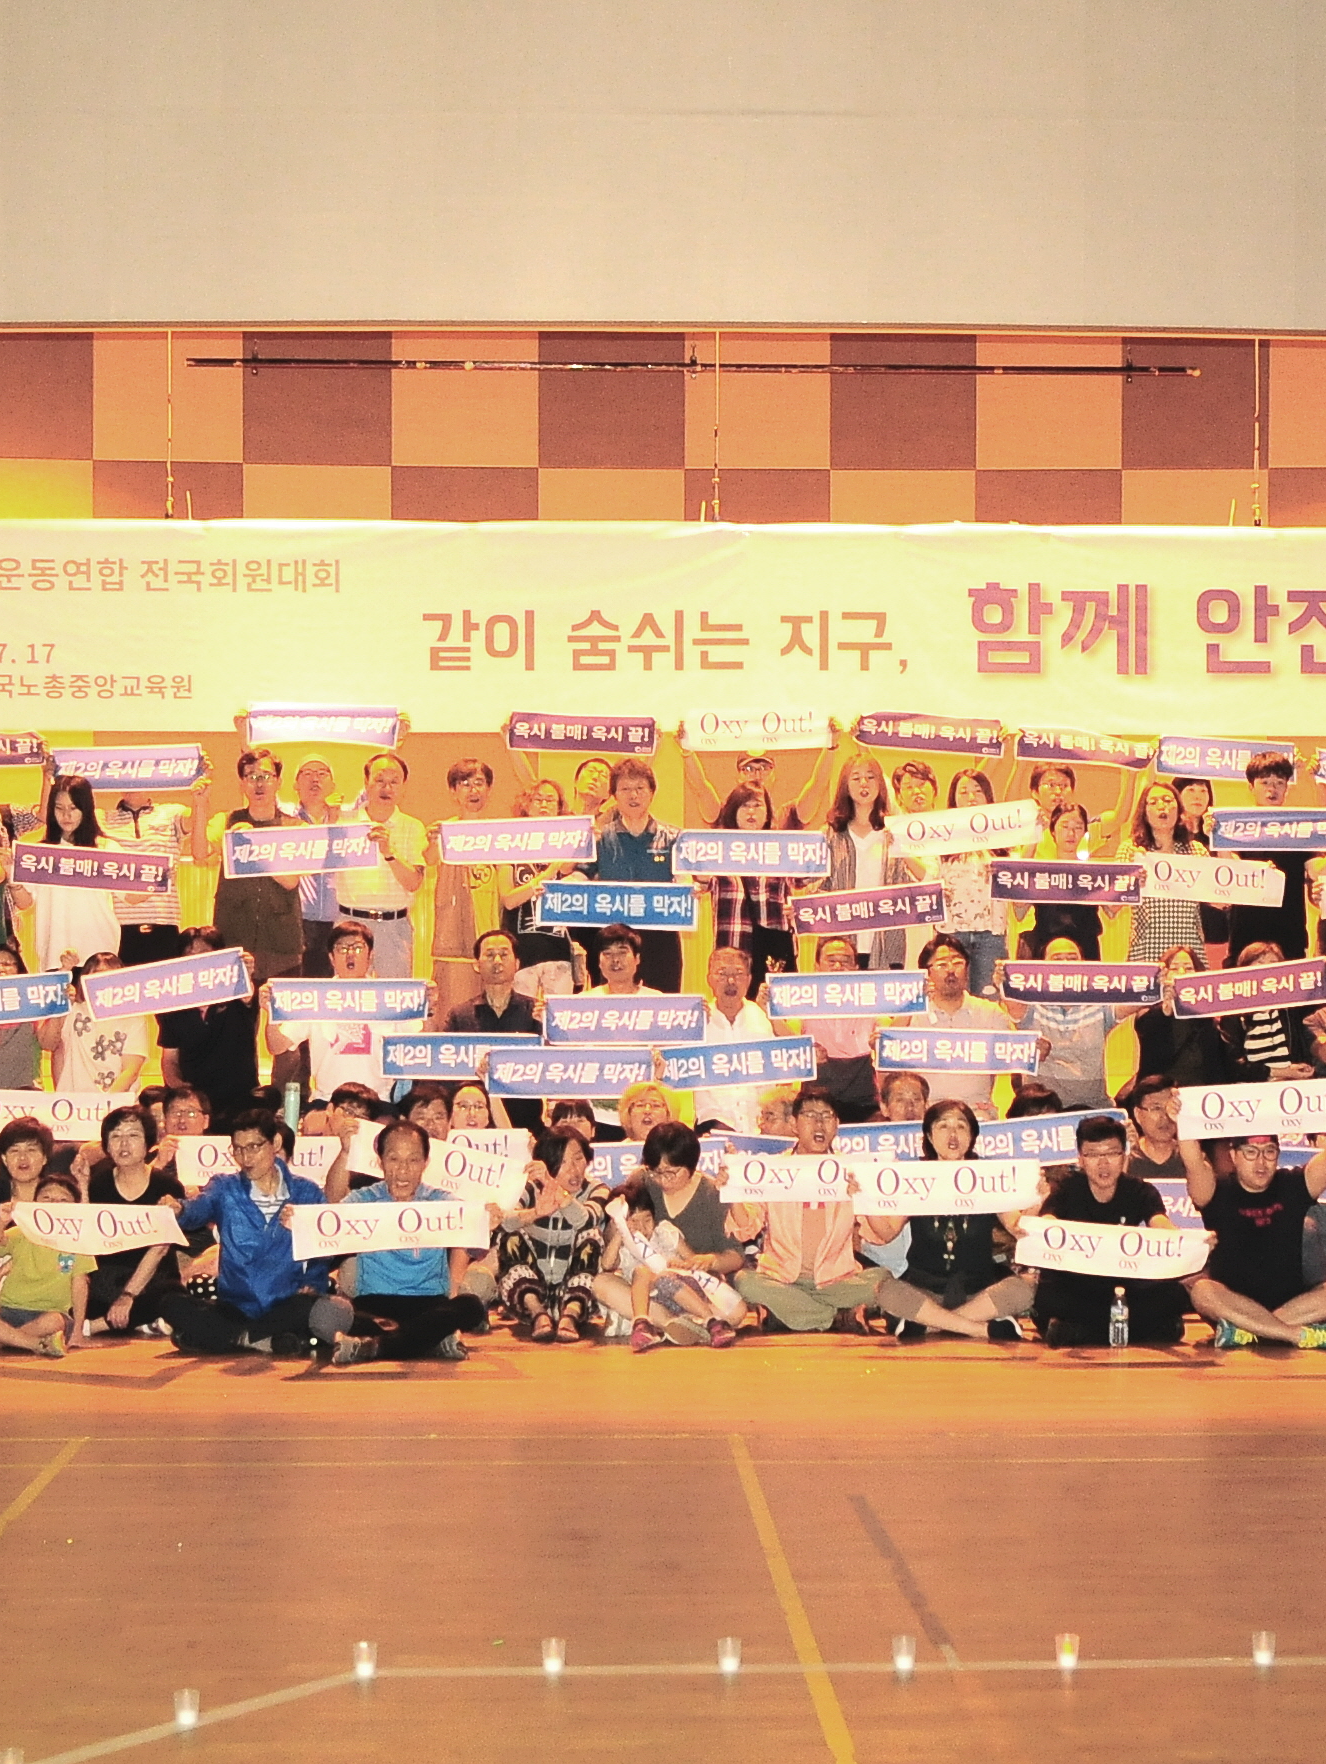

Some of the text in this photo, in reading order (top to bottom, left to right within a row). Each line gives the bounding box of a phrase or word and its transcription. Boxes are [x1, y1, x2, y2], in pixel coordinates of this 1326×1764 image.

[139, 558, 341, 593] 전국회원대회
[422, 609, 535, 671] 같이
[567, 609, 749, 671] 숨쉬는
[780, 610, 908, 674] 지구,
[967, 582, 1148, 675] 함께
[26, 643, 56, 664] 17
[515, 723, 649, 742] 옥시 불매! 옥시 끝!
[700, 712, 813, 739] Oxy Out!
[679, 841, 826, 865] 제2의 옥시를 막자!
[21, 855, 163, 881] 옥시 불매! 옥시 끝!
[997, 870, 1135, 891] 옥시 불매! 옥시 끝!
[545, 893, 691, 918] 제2의 옥시를 막자!
[96, 966, 236, 1008] 제2의 옥시를 막자!
[774, 983, 923, 1006] 제2의 옥시를 막자!
[1009, 975, 1154, 992] 옥시 불매! 옥시 끝!
[276, 989, 424, 1012] 제2의 옥시를 막자!
[882, 1040, 1035, 1063] 제2의 옥시를 막자!
[1201, 1093, 1260, 1122] Oxy
[878, 1166, 1016, 1199] Oxy Out!
[33, 1208, 158, 1240] Oxy Out!
[316, 1207, 464, 1240] Oxy Out!
